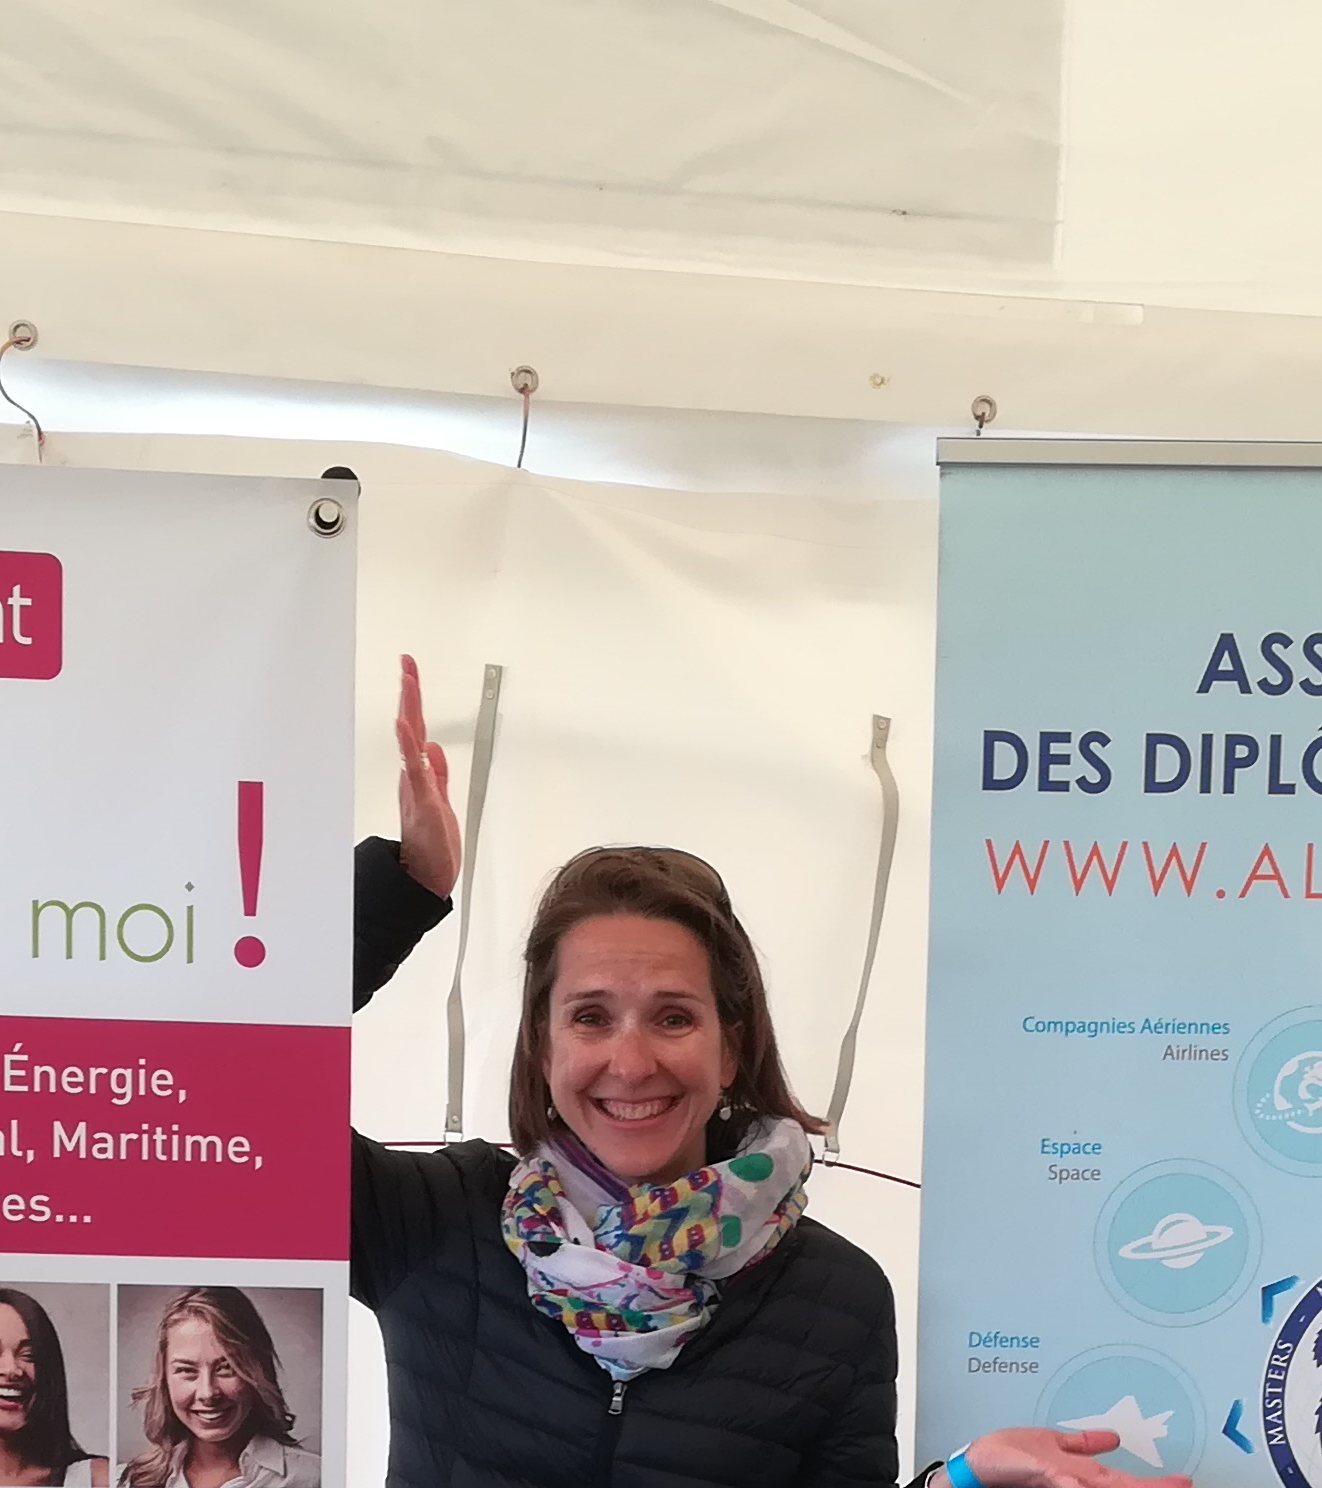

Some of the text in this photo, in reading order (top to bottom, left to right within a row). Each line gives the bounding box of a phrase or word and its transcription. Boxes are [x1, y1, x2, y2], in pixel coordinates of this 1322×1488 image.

[981, 728, 1114, 794] DES
[29, 880, 197, 966] moi
[1022, 1016, 1231, 1037] Compagnies Aériennes
[1162, 1043, 1230, 1063] Airlines
[2, 1042, 188, 1105] Énergie,
[52, 1119, 264, 1170] Maritime,
[1040, 1138, 1102, 1160] Espace
[1047, 1164, 1101, 1186] Space
[967, 1331, 1041, 1351] Défense
[967, 1356, 1040, 1376] Defense
[1264, 1339, 1295, 1446] MASTERS
